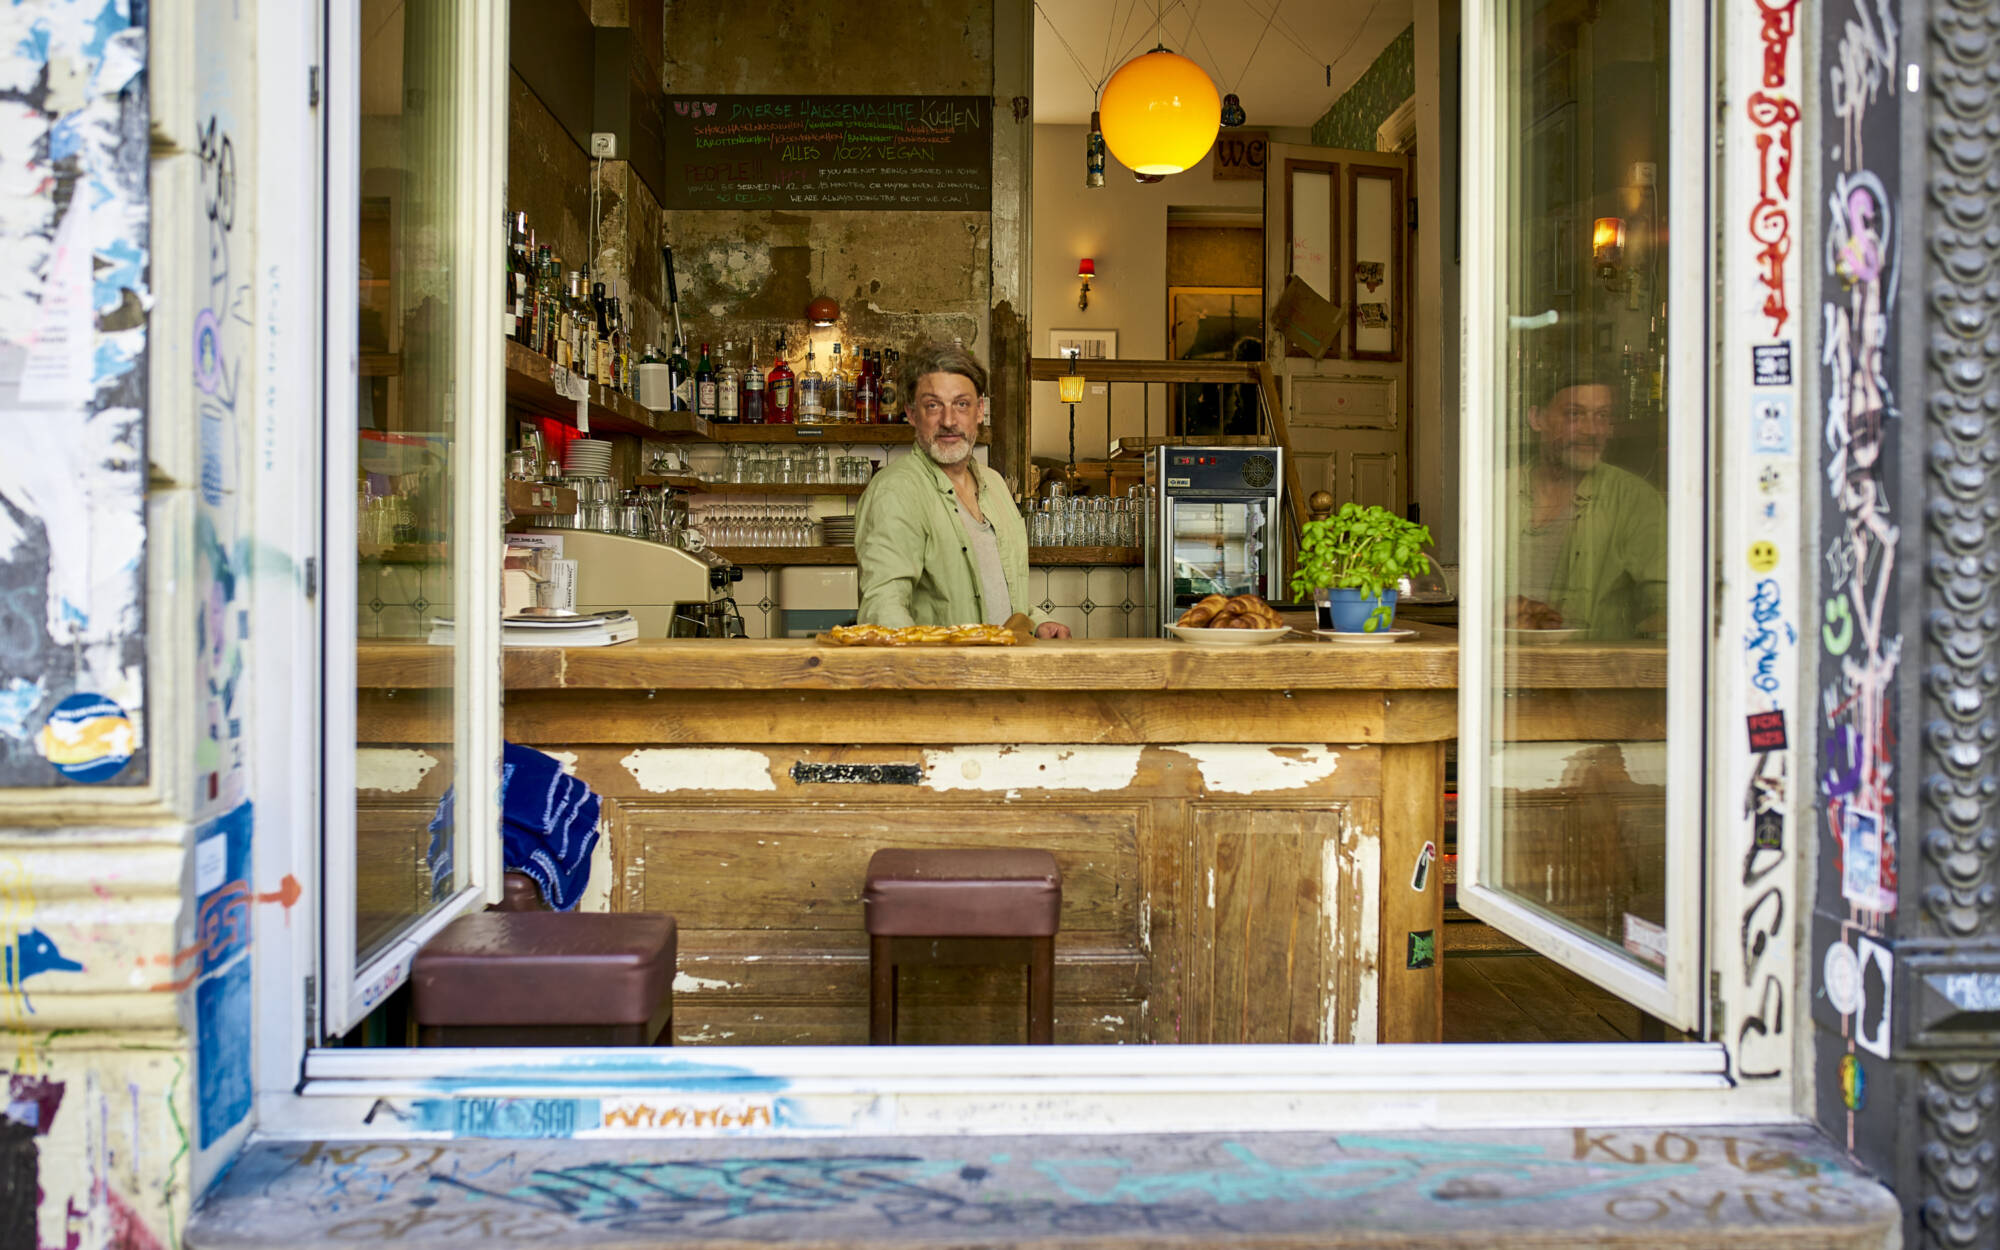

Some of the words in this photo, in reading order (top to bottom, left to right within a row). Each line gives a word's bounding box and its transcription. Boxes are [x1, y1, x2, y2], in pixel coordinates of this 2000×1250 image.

[673, 101, 718, 119] USW
[730, 103, 793, 121] DIVERSE
[800, 98, 915, 121] HAUSGEMACHTE
[920, 98, 980, 131] KUCHEN
[782, 145, 822, 162] ALLES
[833, 145, 873, 162] 100%
[878, 146, 935, 163] VEGAN
[1218, 140, 1264, 167] WC
